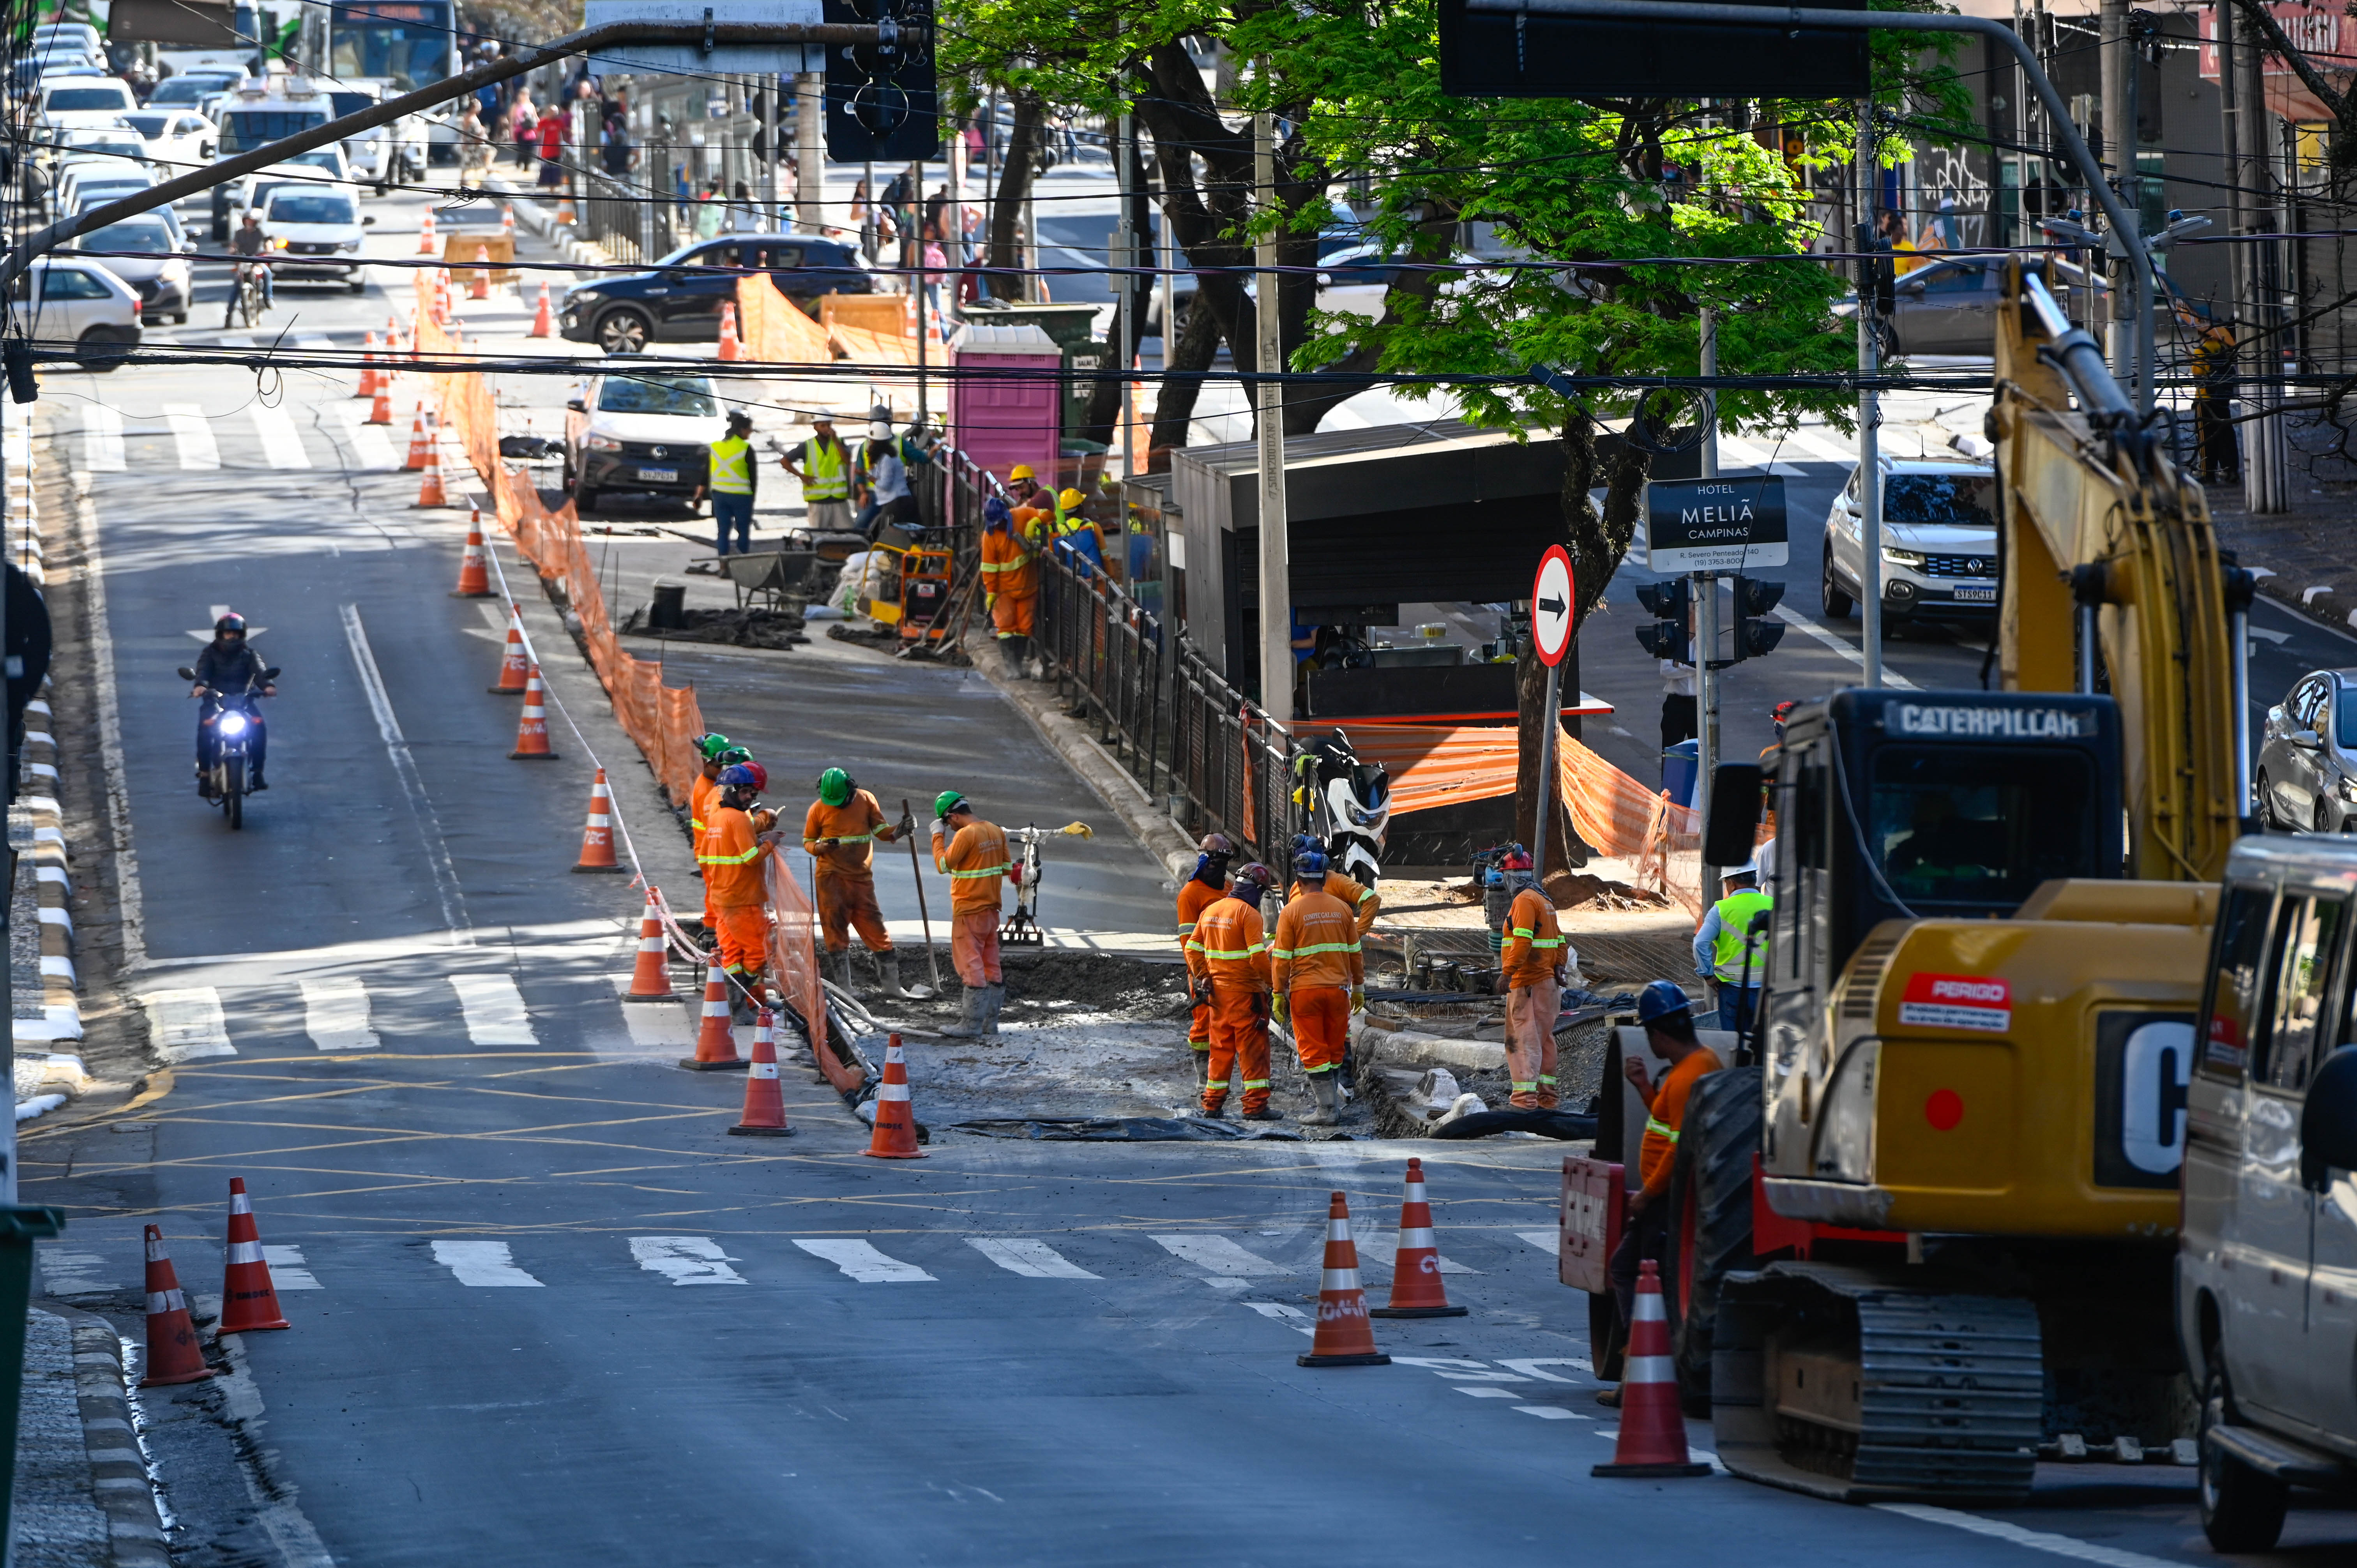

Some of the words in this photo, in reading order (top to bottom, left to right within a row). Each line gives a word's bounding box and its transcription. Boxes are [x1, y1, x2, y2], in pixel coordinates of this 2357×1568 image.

[1689, 527, 1749, 539] CAMPINAS
[1900, 704, 2080, 738] CATERPILLAR
[1303, 912, 1321, 921] COMPEC
[1931, 980, 2005, 1002] PERIGO
